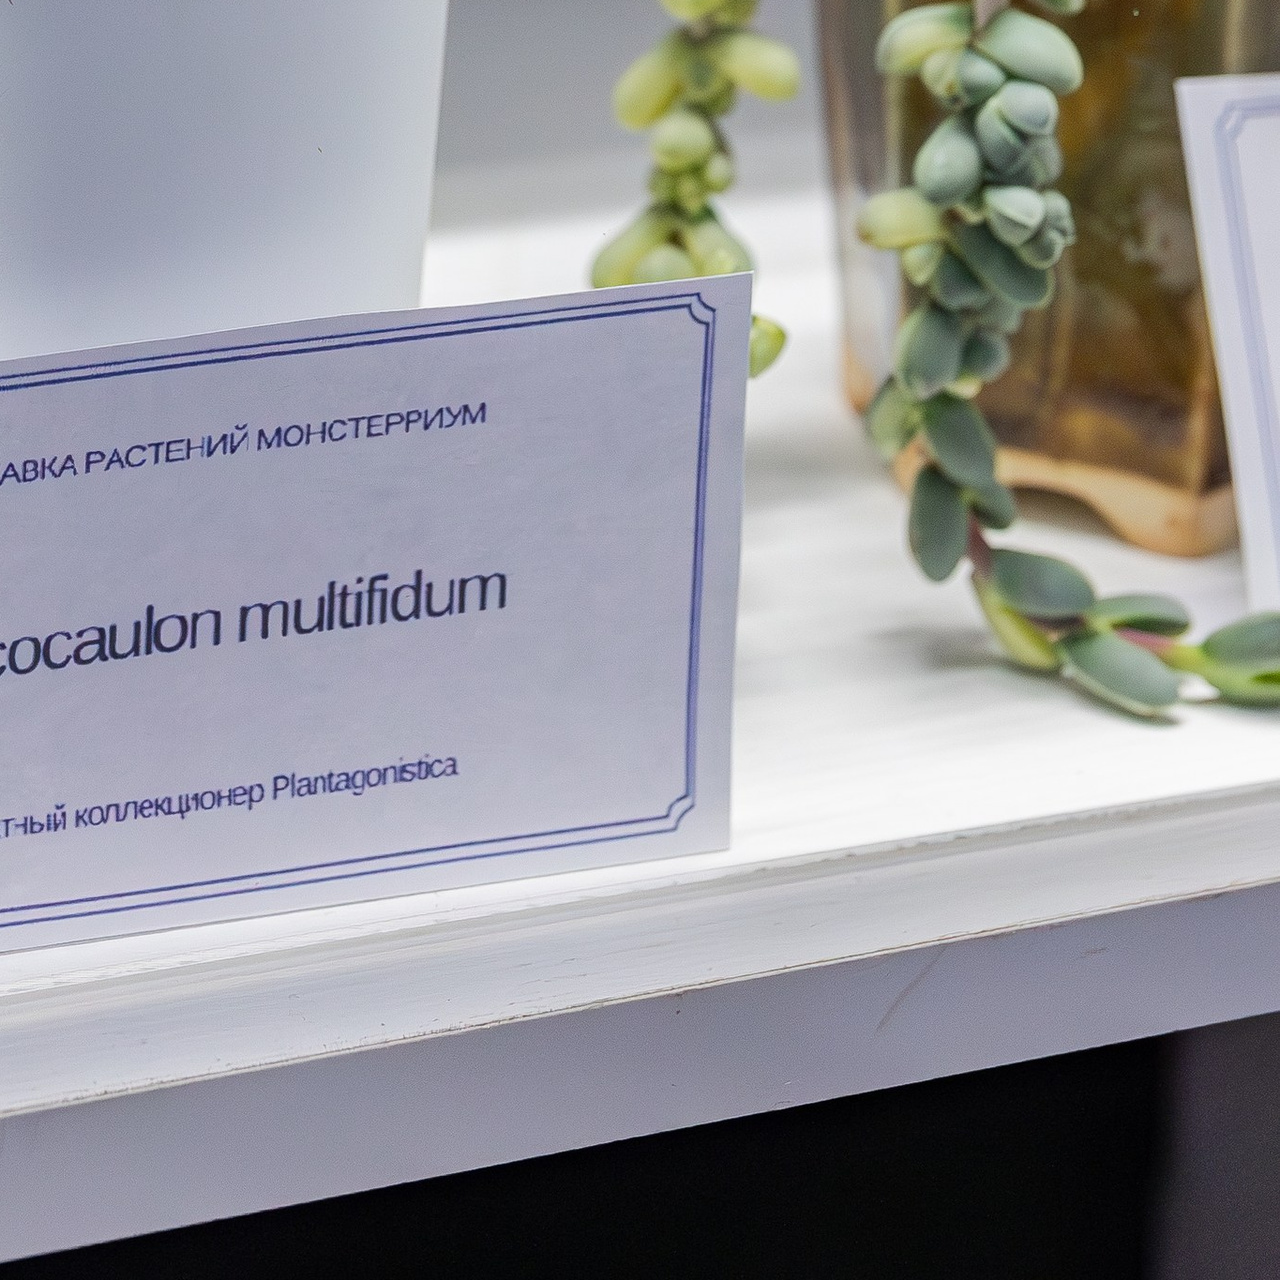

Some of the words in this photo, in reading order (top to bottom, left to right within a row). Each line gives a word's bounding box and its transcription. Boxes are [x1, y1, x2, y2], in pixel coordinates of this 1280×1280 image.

[84, 423, 250, 475] РАСТЕНИЙ
[256, 401, 488, 452] МОНСТЕРРИУМ
[237, 568, 509, 644] multifidum
[74, 783, 267, 829] коллекционер
[271, 753, 460, 802] Plantagonistica
